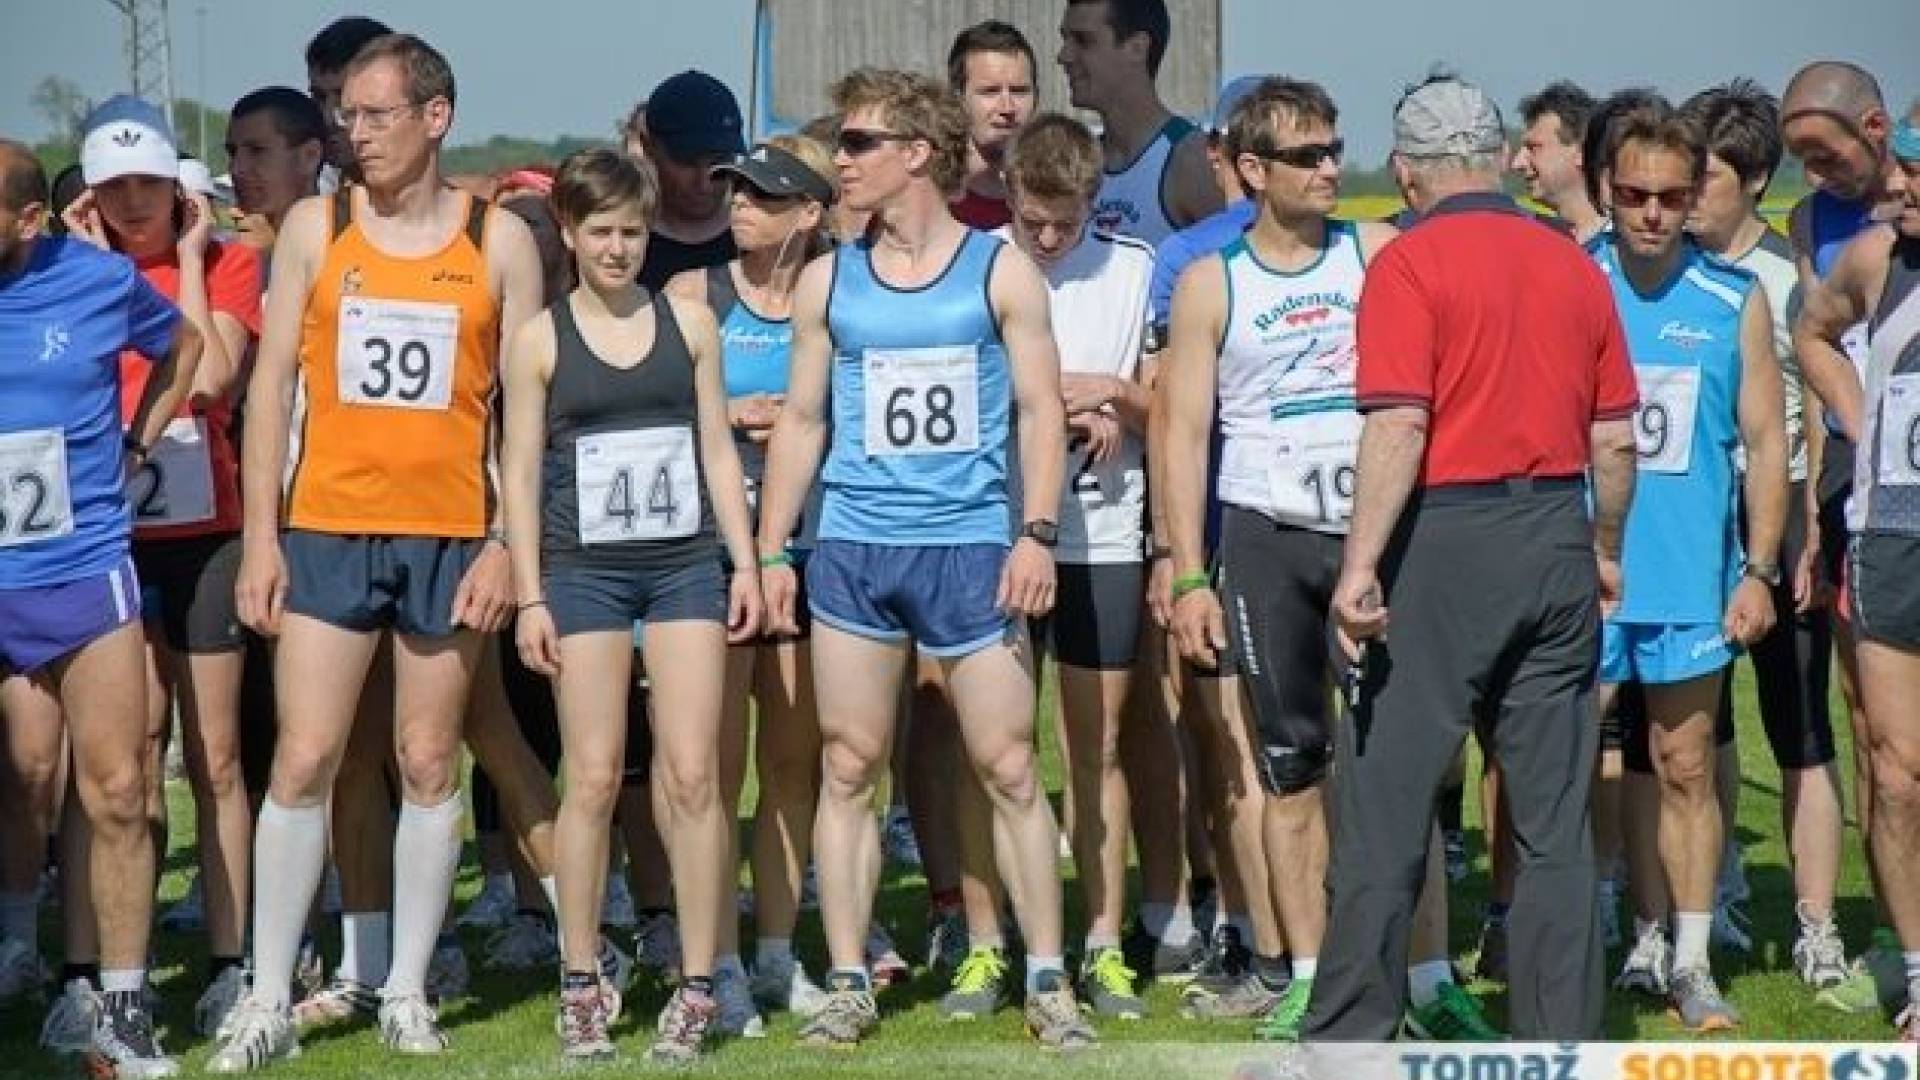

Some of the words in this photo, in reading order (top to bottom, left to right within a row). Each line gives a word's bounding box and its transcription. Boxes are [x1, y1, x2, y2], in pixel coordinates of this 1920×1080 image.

[361, 336, 431, 401] 39
[885, 385, 957, 447] 68
[1638, 404, 1668, 458] 9
[0, 472, 55, 532] 2
[605, 465, 681, 532] 44
